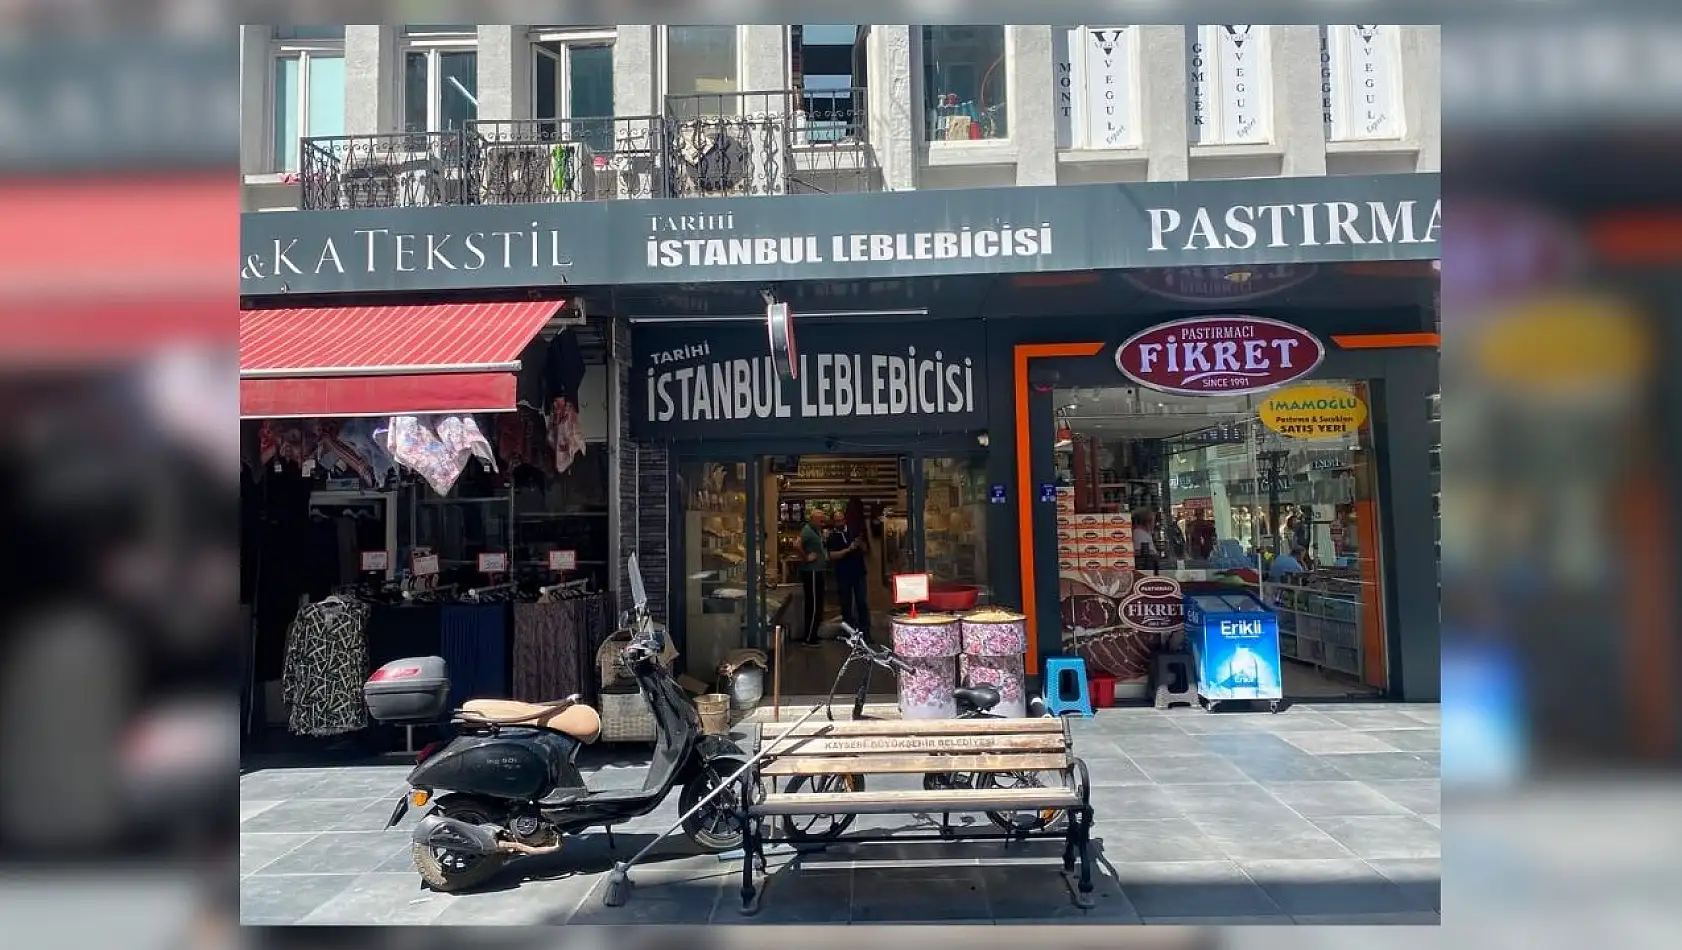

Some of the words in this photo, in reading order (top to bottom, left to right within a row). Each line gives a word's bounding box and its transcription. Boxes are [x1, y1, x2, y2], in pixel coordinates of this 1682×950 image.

[1060, 63, 1071, 116] MONT
[1321, 38, 1332, 123] JOGGER
[648, 211, 734, 231] TARİHİ
[1147, 199, 1441, 251] PASTIRMA
[647, 235, 823, 268] İSTANBUL
[833, 223, 1052, 262] LEBLEBİCİSİ
[650, 339, 710, 364] TARİHİ
[1181, 326, 1254, 340] PASTIRMACI
[1139, 335, 1299, 373] FİKRET
[801, 346, 974, 418] LEBLEBİCİSİ
[1230, 377, 1249, 387] 1991
[1221, 620, 1262, 635] Erikli
